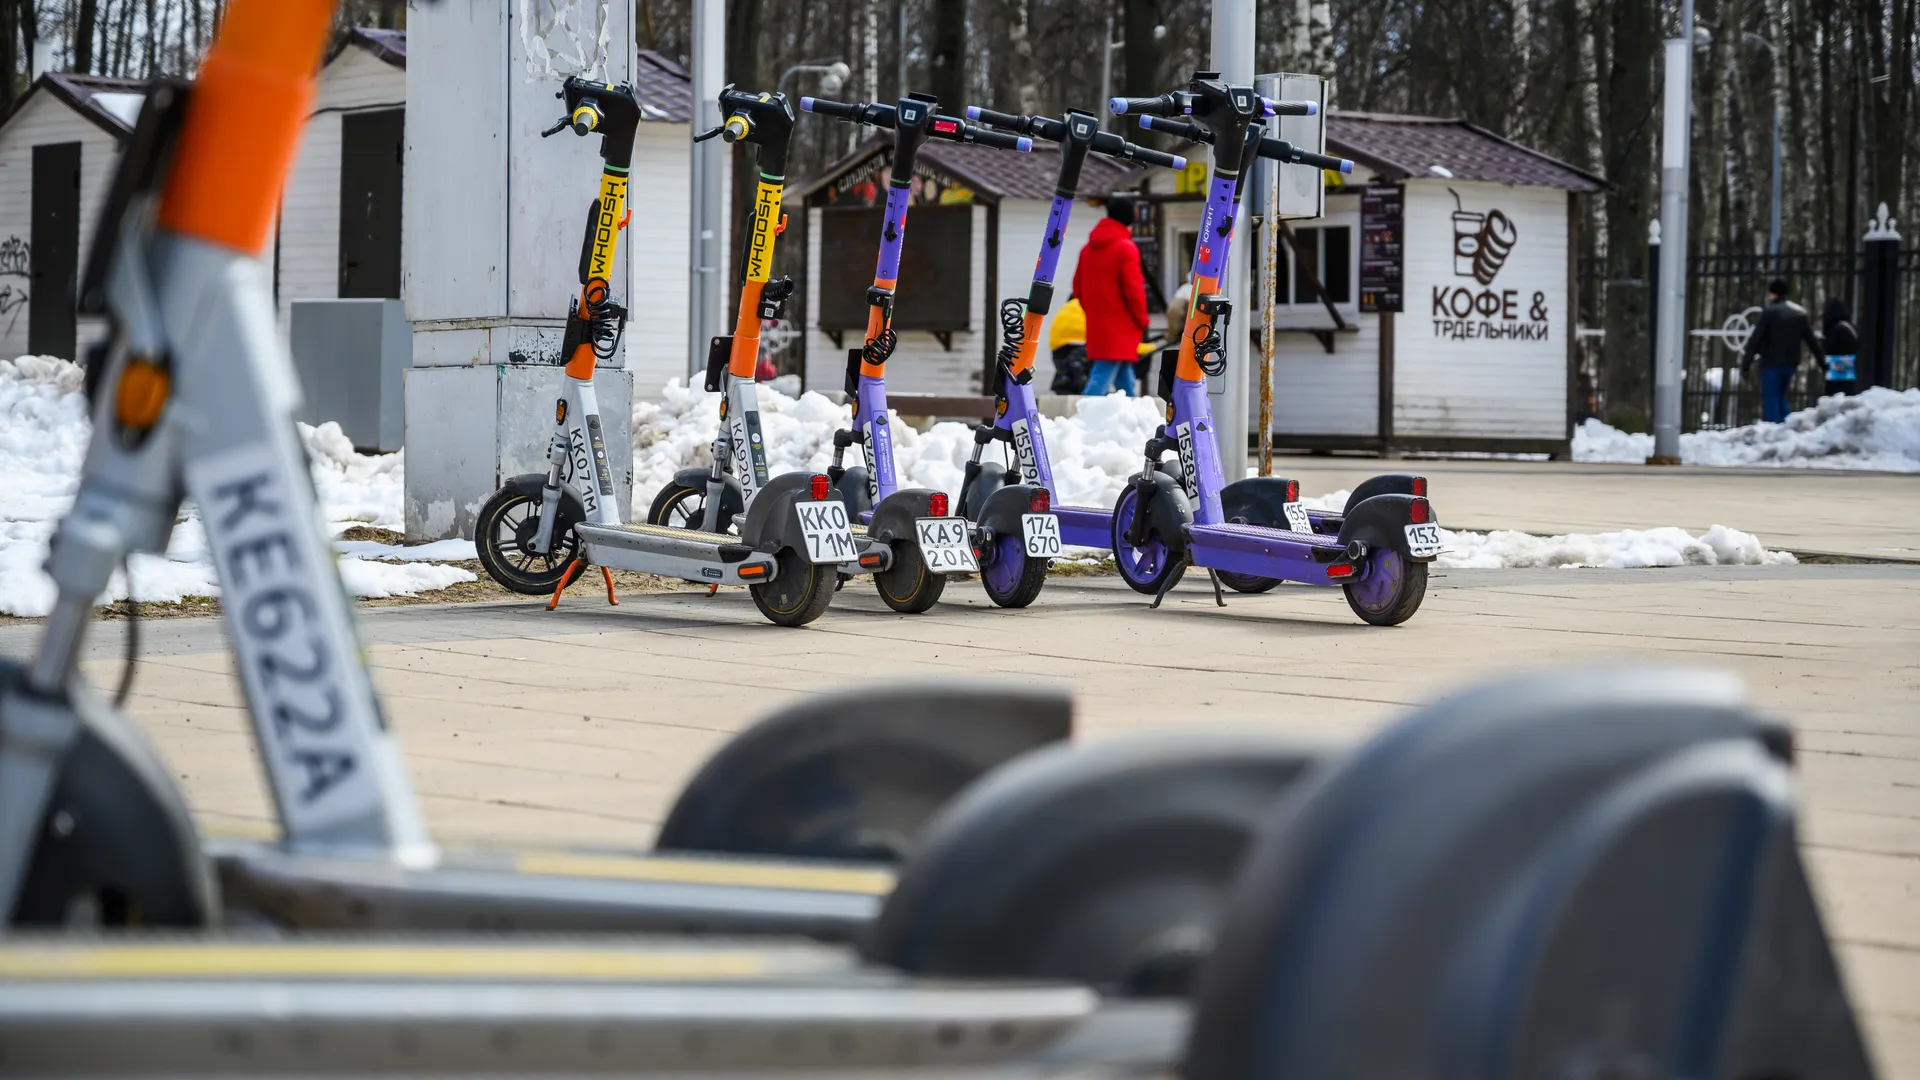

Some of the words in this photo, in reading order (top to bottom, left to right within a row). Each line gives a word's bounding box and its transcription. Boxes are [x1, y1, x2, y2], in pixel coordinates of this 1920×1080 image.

[591, 181, 619, 274] WHOOSH
[749, 189, 772, 277] WHOOSH
[1203, 204, 1214, 243] ЮРЕНТ
[1432, 286, 1518, 319] КОФЕ
[1529, 290, 1549, 321] &
[1433, 320, 1549, 341] ТРДЕЛЬНИКИ
[864, 431, 878, 496] 174670
[1179, 427, 1198, 500] 153831
[1026, 517, 1056, 535] 174
[1286, 504, 1306, 521] 155
[1029, 536, 1060, 554] 670
[1409, 526, 1439, 544] 153
